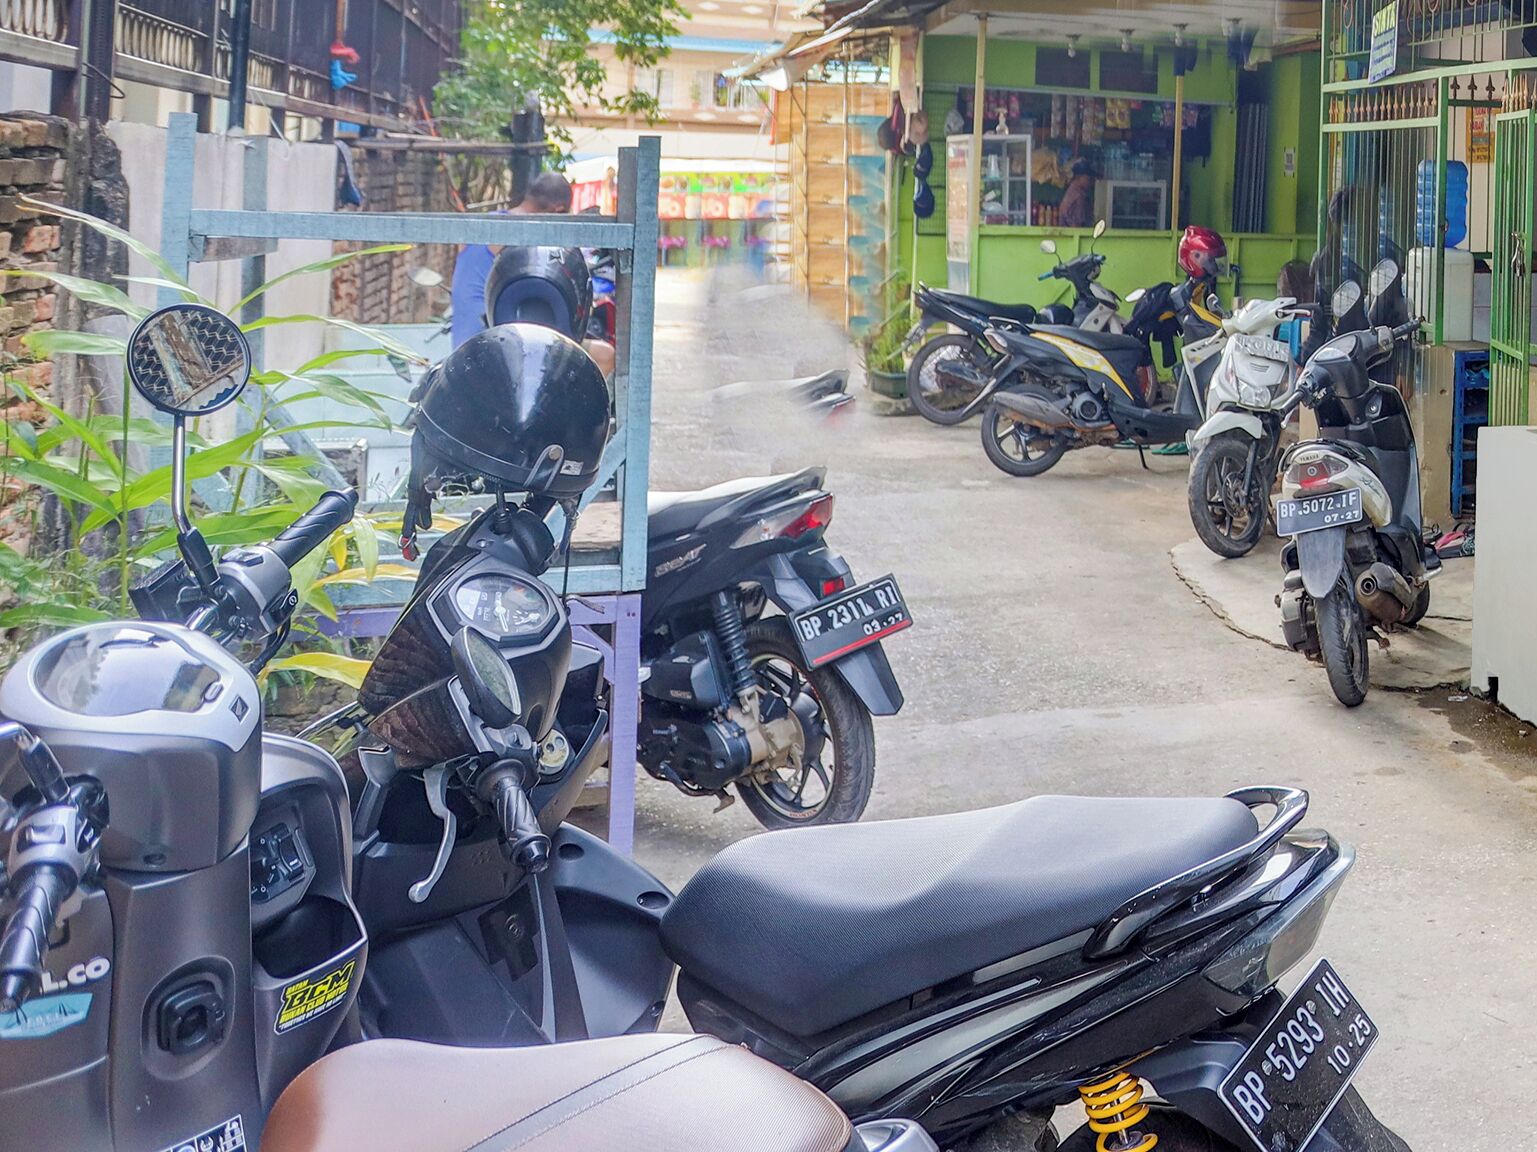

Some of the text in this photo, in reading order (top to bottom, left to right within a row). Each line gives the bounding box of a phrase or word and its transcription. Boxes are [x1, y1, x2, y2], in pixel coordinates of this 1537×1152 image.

[1280, 491, 1357, 518] BP 5072 IF
[800, 615, 822, 641] BP
[40, 957, 110, 993] L.CO
[1232, 971, 1350, 1125] BP 5293 IH
